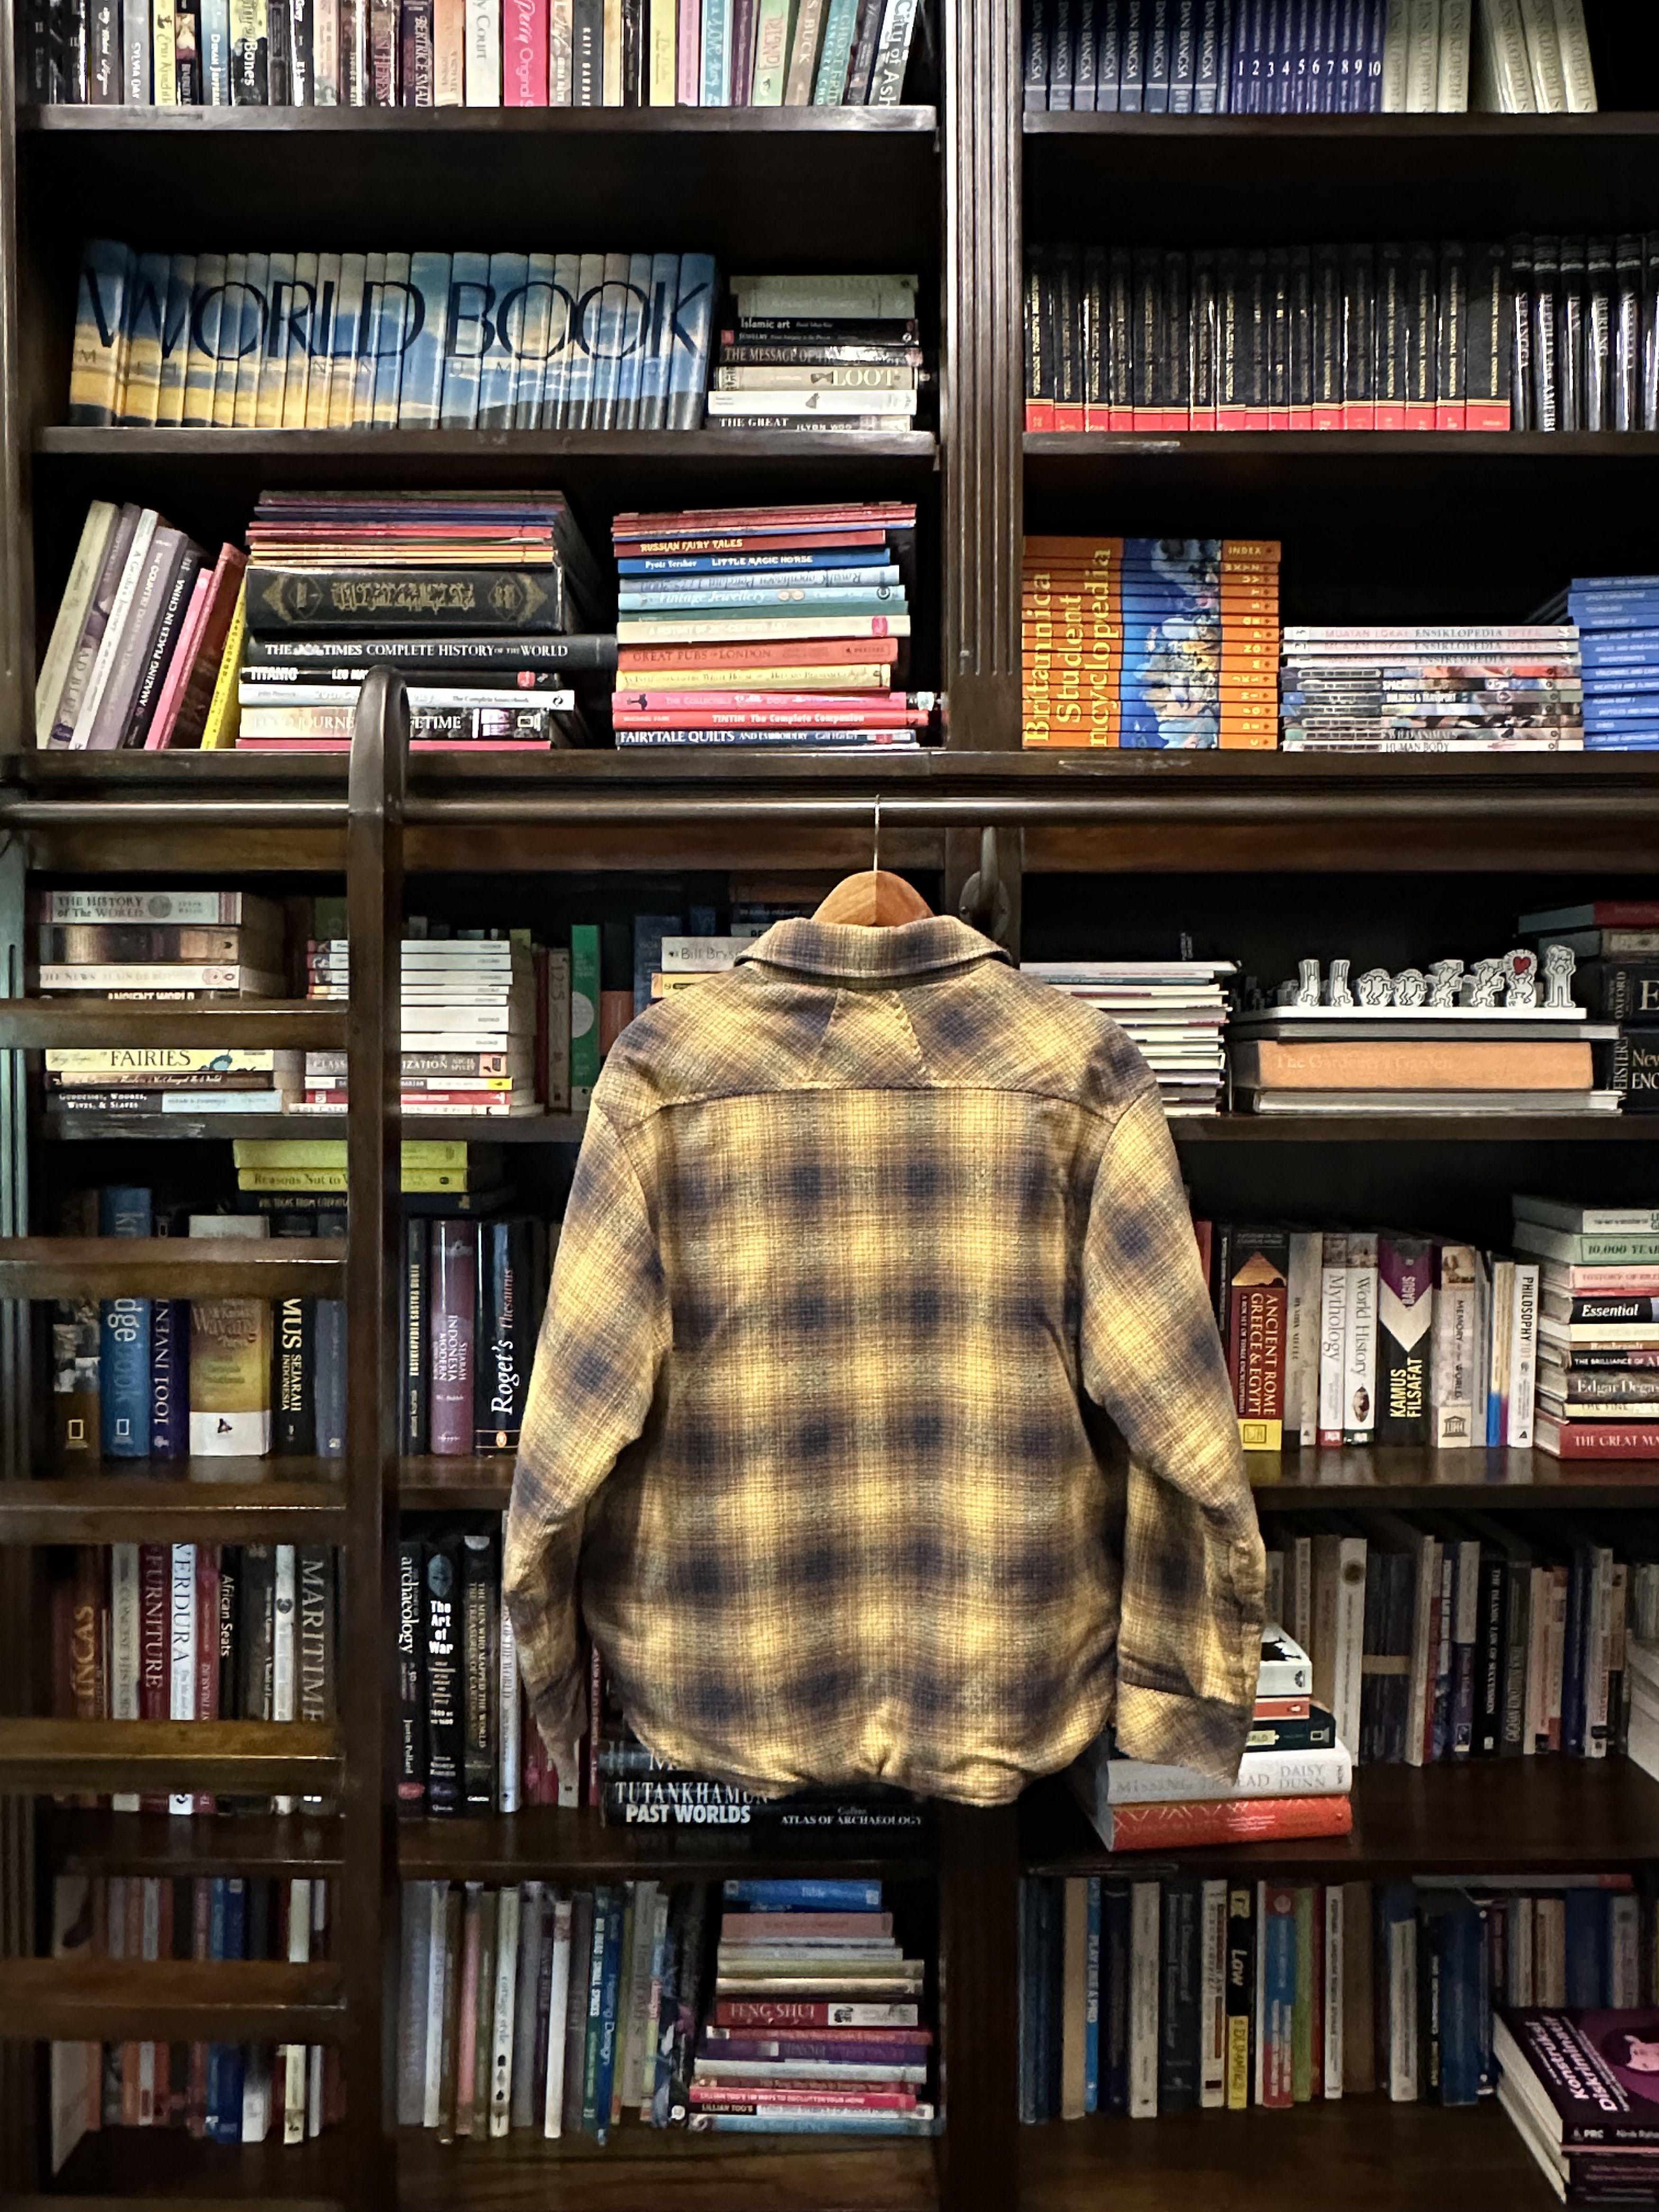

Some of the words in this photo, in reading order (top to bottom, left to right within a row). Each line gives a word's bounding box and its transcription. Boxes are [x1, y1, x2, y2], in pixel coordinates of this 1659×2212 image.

[885, 0, 913, 43] City
[475, 15, 491, 59] Court
[799, 19, 816, 64] BUCK
[244, 42, 258, 87] Bones
[889, 48, 902, 65] of
[1030, 32, 1042, 81] BANGSA
[1057, 31, 1068, 80] BANGSA
[1081, 31, 1092, 81] BANGSA
[1104, 31, 1116, 80] BANGSA
[1127, 31, 1139, 80] BANGSA
[1153, 30, 1165, 79] BANGSA
[1178, 31, 1190, 79] BANGSA
[1203, 31, 1214, 80] BANGSA
[516, 48, 534, 99] Original
[1238, 59, 1243, 76] 1
[1251, 60, 1259, 76] 2
[1267, 60, 1274, 77] 3
[1281, 60, 1290, 77] 4
[1297, 57, 1305, 74] 5
[1312, 59, 1320, 76] 6
[1327, 60, 1334, 76] 7
[1341, 58, 1349, 75] 8
[1354, 59, 1362, 76] 9
[1368, 60, 1381, 77] 10
[82, 269, 425, 361] WORLD
[447, 280, 709, 364] BOOK
[740, 318, 775, 329] Islamic
[776, 320, 791, 329] art
[1597, 297, 1609, 357] BURUNG
[725, 347, 746, 362] THE
[833, 369, 899, 386] LOOT
[719, 417, 744, 428] THE
[747, 417, 790, 427] GREAT
[640, 541, 680, 553] RUSSIAN
[682, 540, 710, 552] FAIRY
[712, 538, 743, 549] TALES
[1228, 546, 1262, 555] INDEX
[711, 557, 746, 567] LITTLE
[747, 556, 779, 566] MAGIC
[780, 555, 813, 564] HORSE
[168, 579, 186, 613] CHINA
[659, 592, 703, 605] Vintage
[164, 611, 173, 626] IN
[153, 625, 169, 661] PLACES
[1325, 629, 1370, 638] MUATAN
[1374, 629, 1408, 638] LOKAL
[1415, 628, 1502, 638] ENSIKLOPEDIA
[265, 644, 293, 655] THE
[323, 644, 363, 656] TIMES
[366, 644, 435, 656] COMPLETE
[438, 644, 494, 656] HISTORY
[520, 644, 568, 656] WORLD
[633, 651, 674, 662] GREAT
[678, 650, 708, 660] PUBS
[719, 648, 772, 659] LONDON
[1023, 572, 1052, 742] Britannica
[1056, 594, 1084, 724] Student
[138, 661, 160, 706] AMAZING
[331, 669, 349, 680] LEO
[712, 714, 746, 723] TINTIN
[750, 714, 767, 723] The
[769, 714, 812, 725] Complete
[814, 713, 865, 724] Companion
[619, 731, 686, 743] FAIRYTALE
[688, 731, 735, 743] QUILTS
[738, 732, 757, 740] AND
[1386, 743, 1421, 753] HUMAN
[1423, 742, 1449, 753] BODY
[56, 896, 83, 907] THE
[86, 896, 144, 907] HISTORY
[57, 908, 69, 918] of
[72, 908, 92, 917] The
[94, 908, 144, 917] WORLD
[680, 948, 704, 960] Bill
[1614, 971, 1626, 1020] OXFORD
[110, 1050, 191, 1066] FAIRIES
[401, 1059, 448, 1070] IZATION
[1276, 1054, 1305, 1069] The
[254, 1173, 304, 1185] Reasons
[305, 1172, 326, 1185] Not
[329, 1173, 341, 1185] to
[1588, 1245, 1627, 1255] 10,000
[500, 1268, 513, 1329] Thesaurus
[1354, 1276, 1371, 1321] World
[1401, 1275, 1416, 1305] BAGUS
[1322, 1274, 1345, 1362] Mythology
[1521, 1277, 1534, 1342] PHILOSOPHY
[1582, 1304, 1639, 1318] Essential
[1250, 1292, 1264, 1350] GREECE
[1265, 1293, 1280, 1361] ANCIENT
[1456, 1299, 1465, 1343] MEMORY
[438, 1333, 447, 1382] MODERN
[447, 1315, 459, 1382] INDONESIA
[1249, 1352, 1261, 1362] &
[1351, 1324, 1370, 1379] History
[458, 1342, 467, 1381] SEJARAH
[281, 1354, 289, 1411] INDONESIA
[291, 1354, 302, 1412] SEJARAH
[491, 1339, 520, 1415] Roget's
[1453, 1364, 1463, 1399] WORLD
[1577, 1379, 1616, 1396] Edgar
[1247, 1364, 1262, 1416] EGYPT
[1263, 1364, 1277, 1417] ROME
[1390, 1368, 1406, 1418] KAMUS
[1407, 1357, 1422, 1419] FILSAFAT
[154, 1375, 170, 1426] 1001
[1573, 1435, 1595, 1447] THE
[1598, 1435, 1638, 1447] GREAT
[1491, 1569, 1501, 1586] THE
[219, 1574, 235, 1620] African
[478, 1582, 486, 1600] THE
[173, 1543, 192, 1663] VERDURA
[398, 1557, 420, 1654] archaeology
[429, 1600, 452, 1614] The
[478, 1603, 486, 1624] MEN
[1490, 1589, 1499, 1623] ISLAMIC
[145, 1554, 164, 1689] FURNITURE
[430, 1614, 452, 1628] Art
[220, 1622, 234, 1657] Seats
[301, 1559, 325, 1722] MARITIME
[434, 1629, 447, 1641] of
[478, 1627, 486, 1650] WHO
[1489, 1626, 1498, 1645] LAW
[69, 1605, 95, 1698] INCAS
[428, 1640, 454, 1655] War
[1488, 1647, 1497, 1660] OF
[478, 1713, 486, 1748] WORLD
[1280, 1764, 1325, 1776] DAISY
[1279, 1777, 1326, 1789] DUNN
[626, 1804, 669, 1823] PAST
[675, 1804, 751, 1824] WORLDS
[781, 1815, 816, 1825] ATLAS
[818, 1815, 834, 1825] OF
[837, 1815, 923, 1826] ARCHAEOLOGY
[730, 2002, 771, 2018] FENG
[775, 2002, 816, 2018] SHUI
